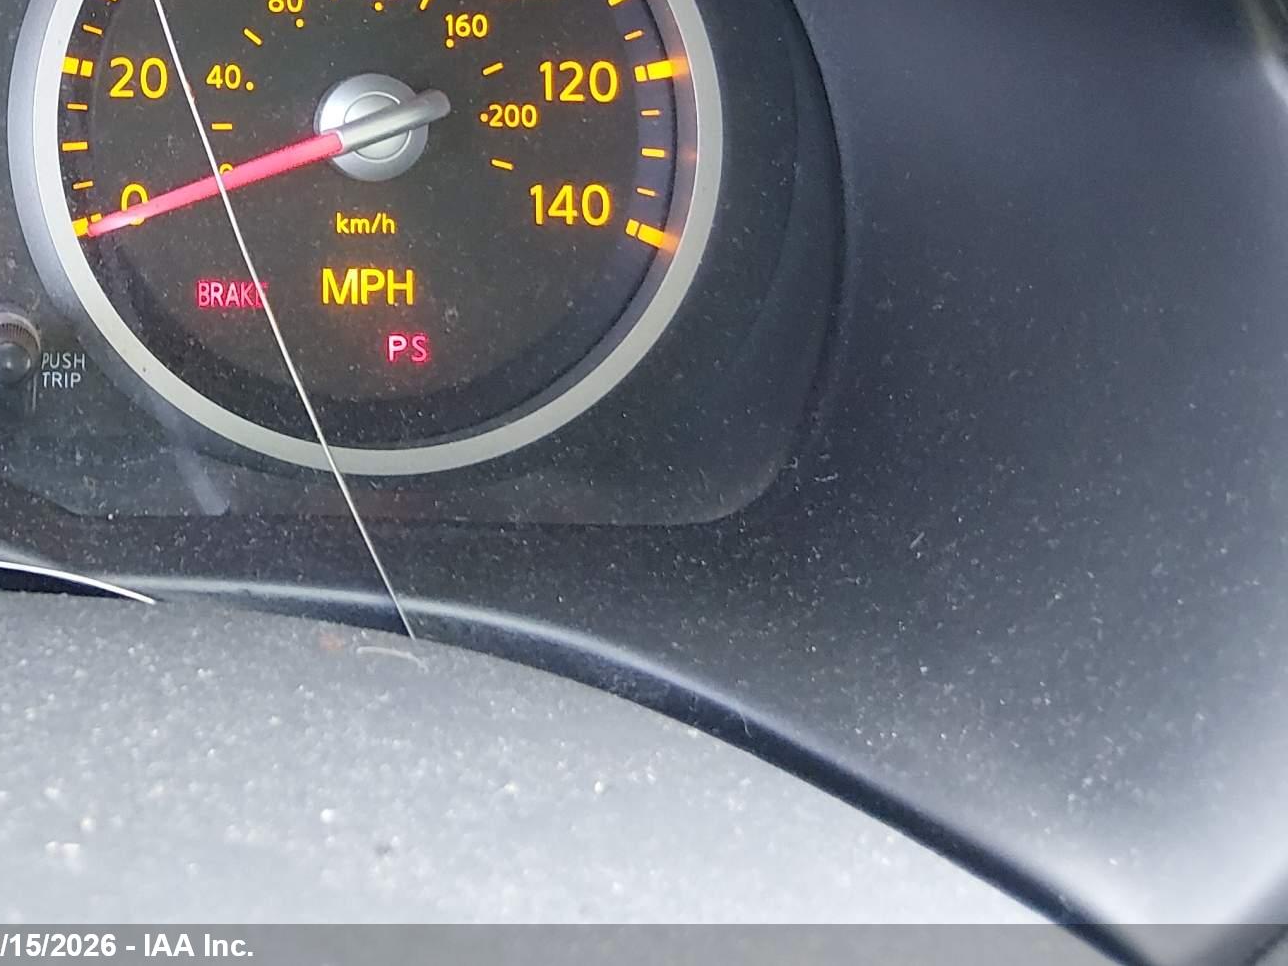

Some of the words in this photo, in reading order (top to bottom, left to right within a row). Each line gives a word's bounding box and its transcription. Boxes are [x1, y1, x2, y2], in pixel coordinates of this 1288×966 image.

[445, 15, 488, 38] 160
[110, 57, 168, 98] 20
[207, 65, 240, 89] 40
[540, 61, 617, 103] 120
[489, 105, 537, 128] 200
[530, 184, 611, 226] 140
[336, 212, 396, 235] km/h
[322, 269, 414, 306] MPH
[42, 352, 87, 369] PUSH
[42, 371, 82, 388] TRIP
